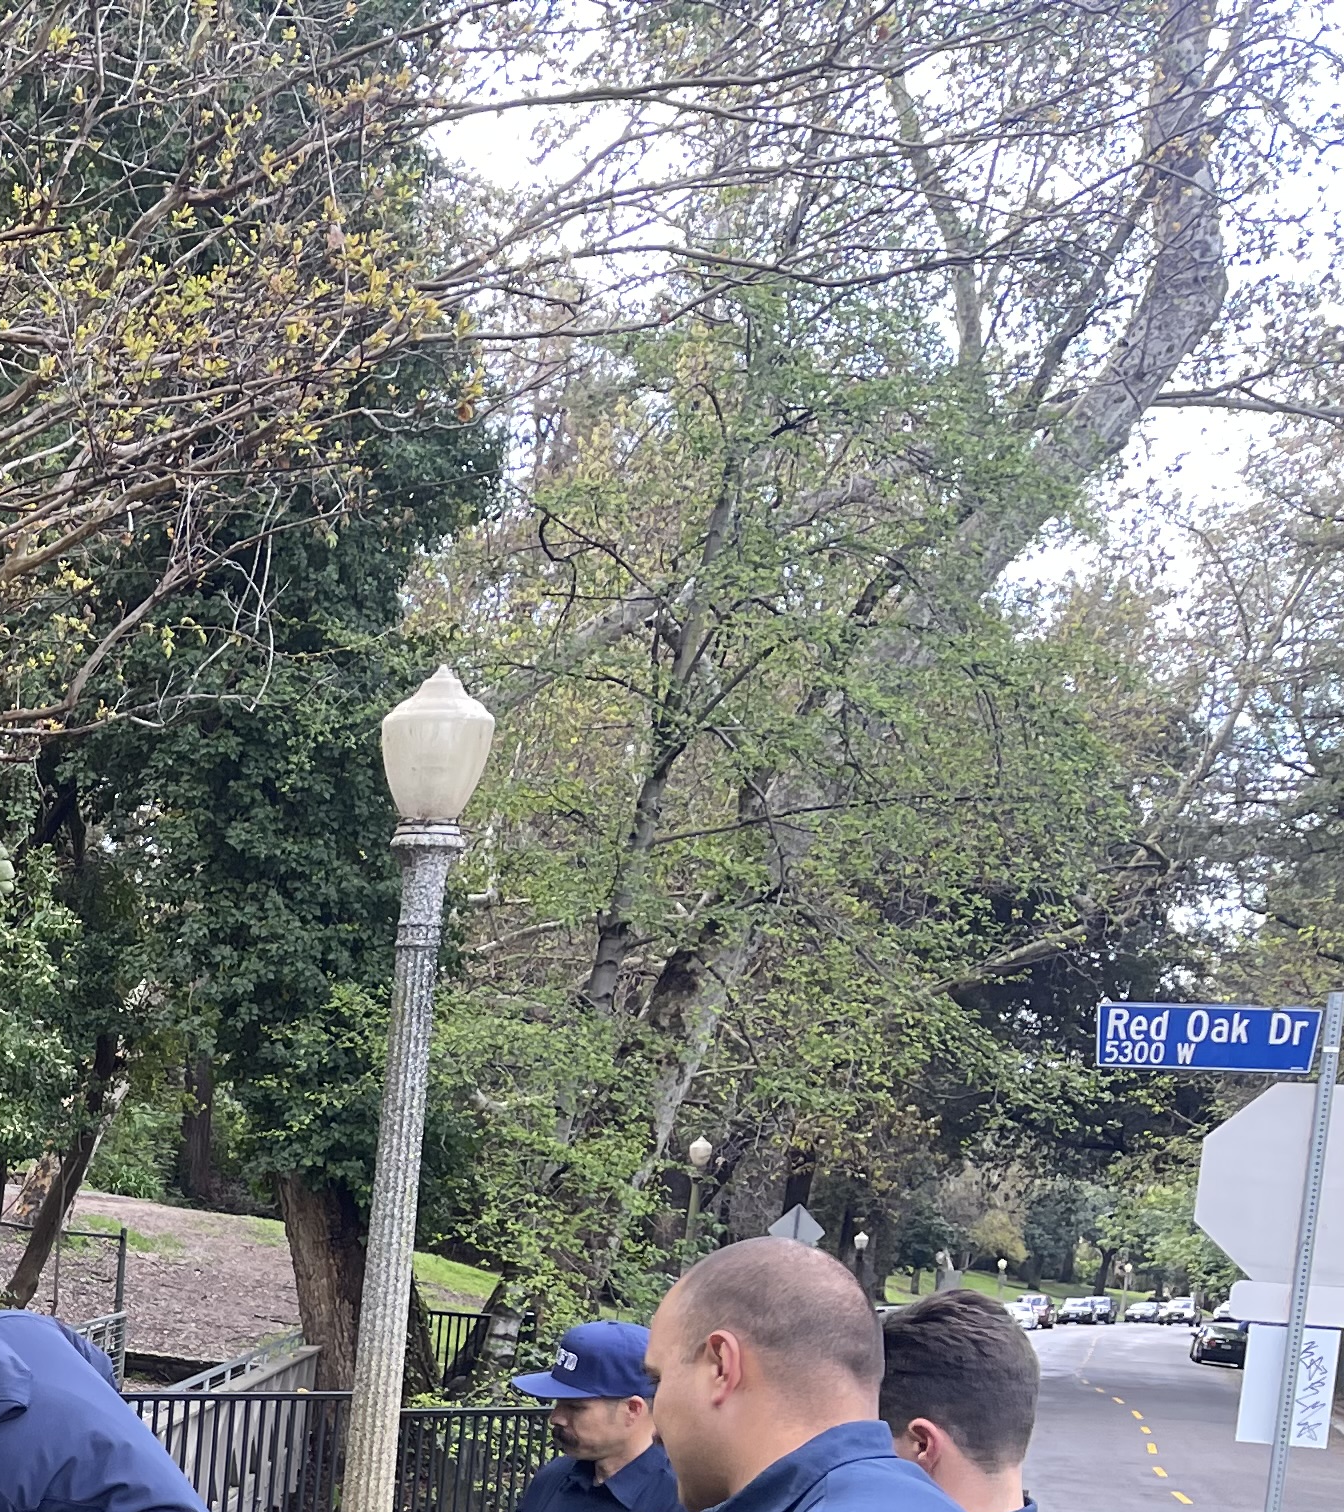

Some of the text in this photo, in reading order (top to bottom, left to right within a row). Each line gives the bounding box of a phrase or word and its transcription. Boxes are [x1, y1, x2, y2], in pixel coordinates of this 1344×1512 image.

[1106, 1008, 1309, 1046] Red Oak Dr
[1104, 1040, 1196, 1065] 5300 W
